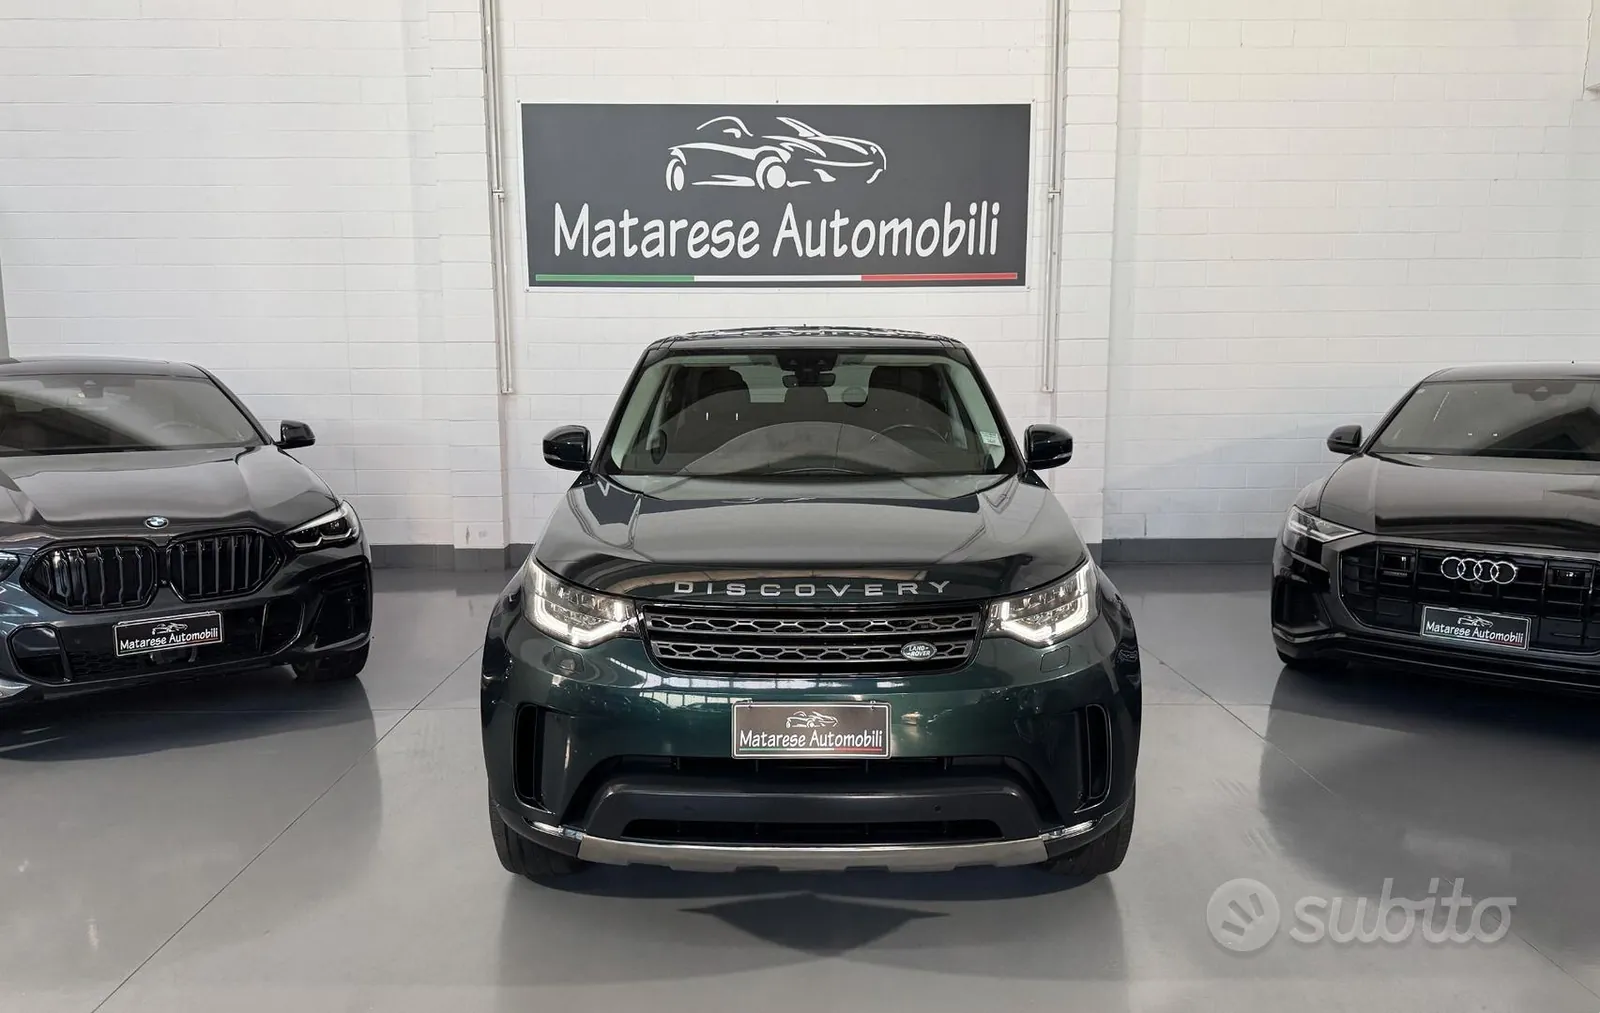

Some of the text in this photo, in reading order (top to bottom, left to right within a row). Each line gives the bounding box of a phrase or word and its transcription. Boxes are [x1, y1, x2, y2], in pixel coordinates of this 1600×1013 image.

[554, 201, 1000, 258] Matarese Automobili
[674, 580, 950, 597] DISCOVERY
[120, 628, 218, 650] Matarese Automobili
[1426, 620, 1523, 643] Matarese Automobili
[739, 730, 883, 748] Matarese Automobili
